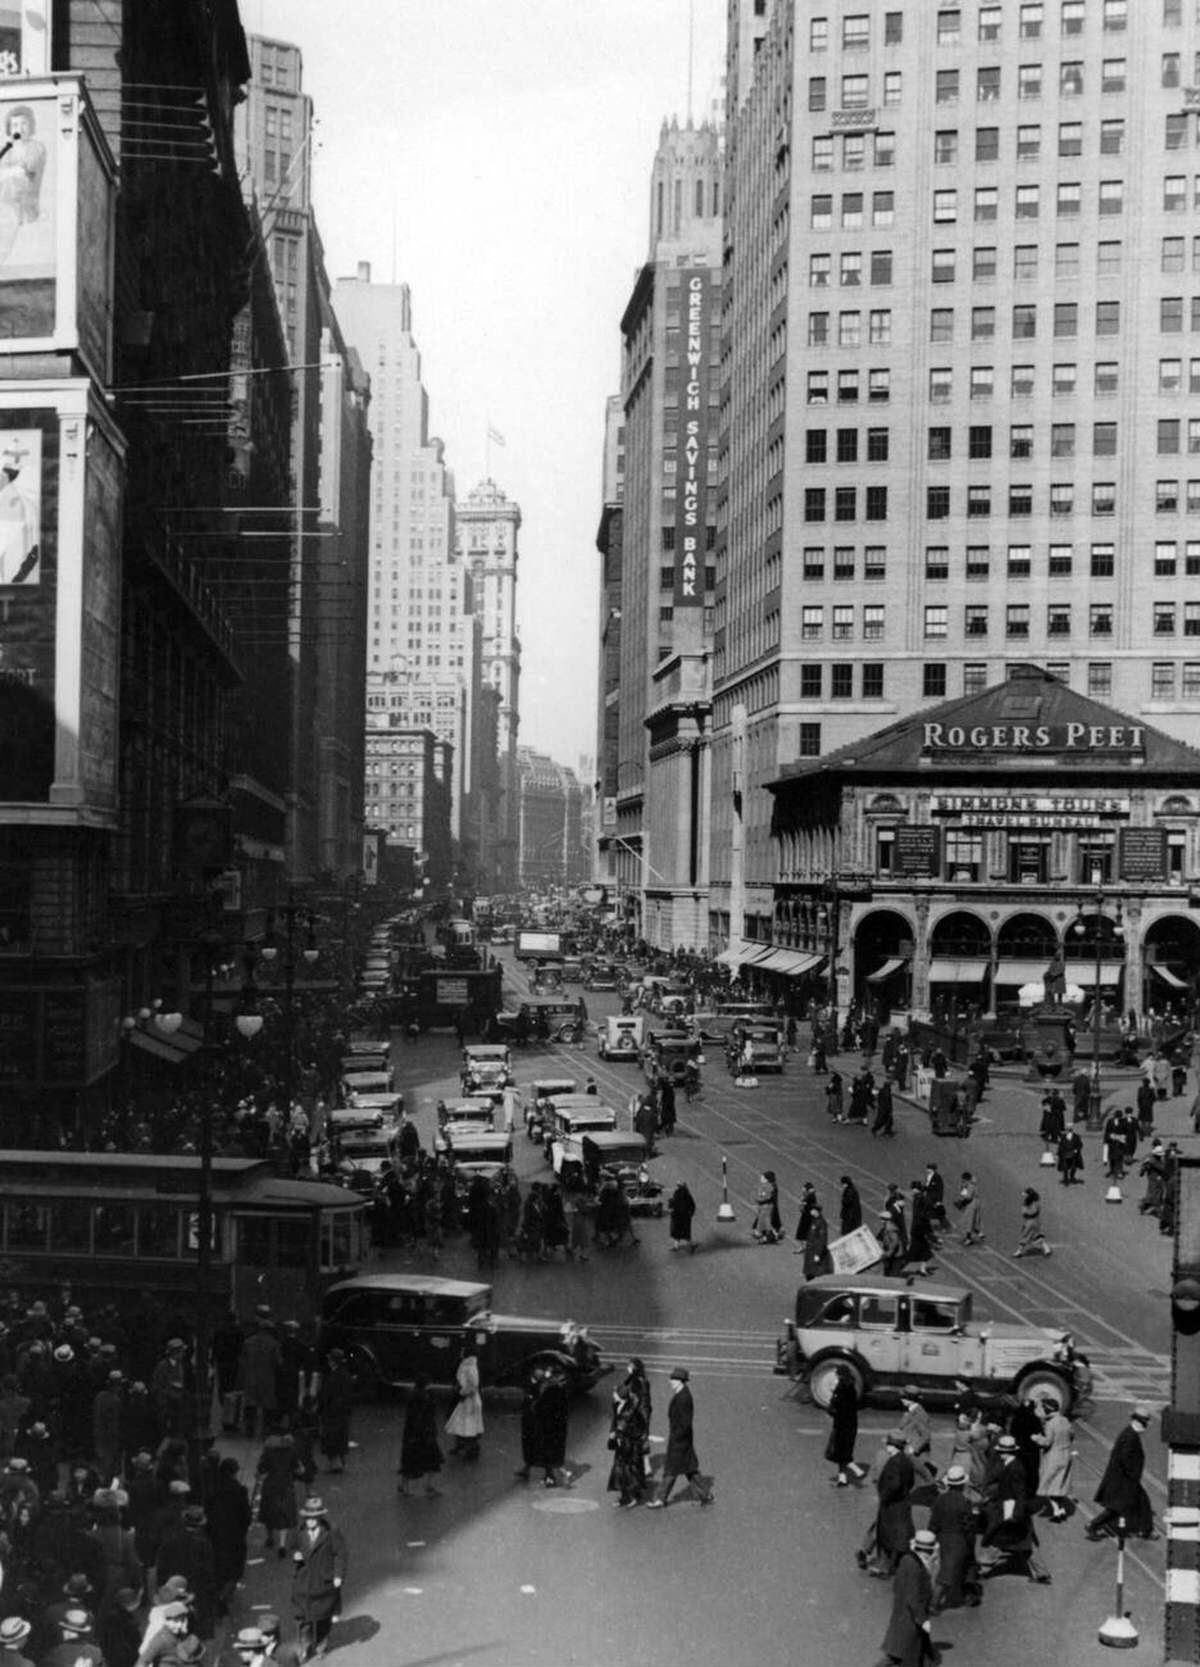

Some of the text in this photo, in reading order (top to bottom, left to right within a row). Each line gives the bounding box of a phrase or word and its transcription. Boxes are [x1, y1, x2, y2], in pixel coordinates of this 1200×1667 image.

[682, 276, 703, 597] GREENWICH SAVINGS BANK
[923, 722, 1145, 747] ROGERS PEET
